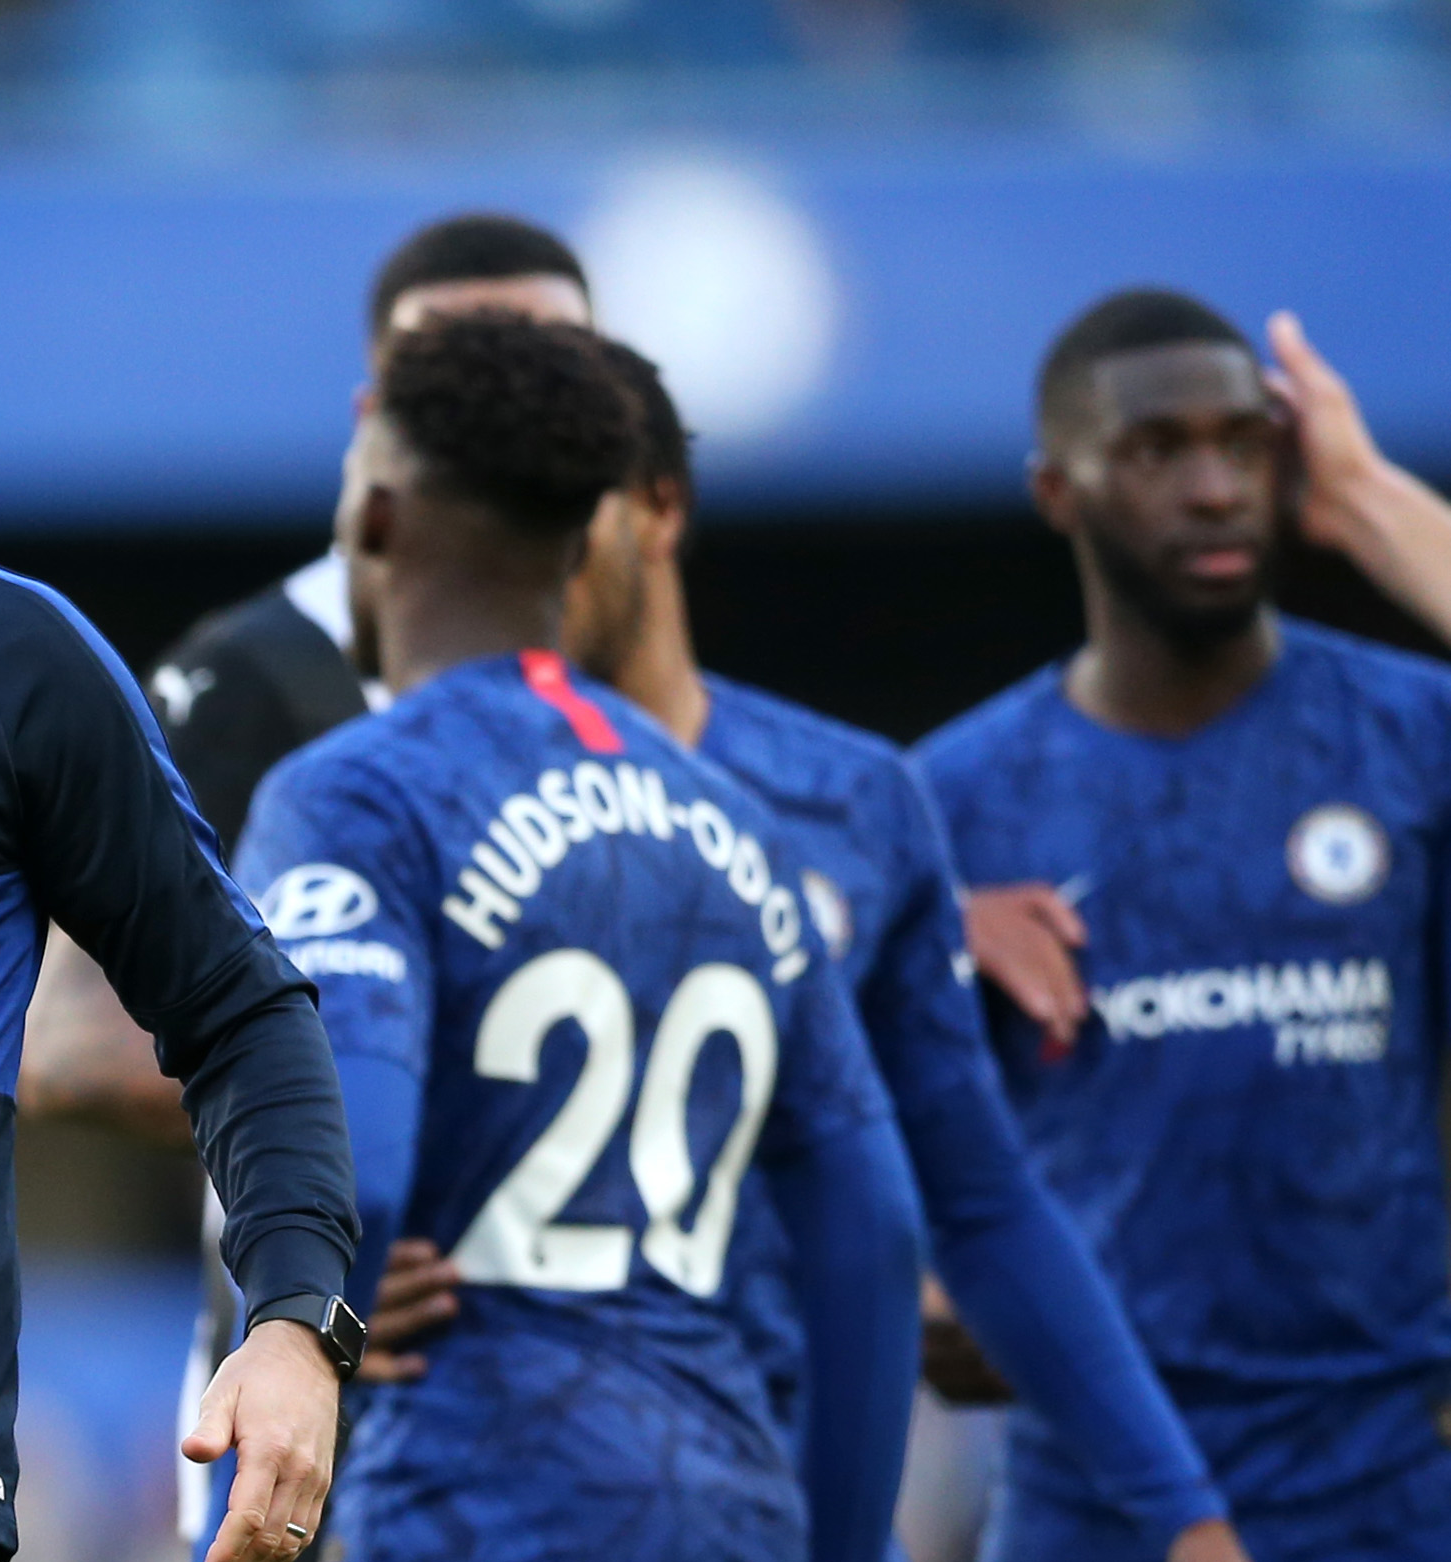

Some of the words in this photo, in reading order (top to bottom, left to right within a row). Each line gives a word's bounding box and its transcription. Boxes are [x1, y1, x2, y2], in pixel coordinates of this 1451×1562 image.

[441, 760, 809, 986] HUDSON-ODOI
[1091, 956, 1395, 1044] YOKOHAMA
[455, 946, 779, 1298] 20
